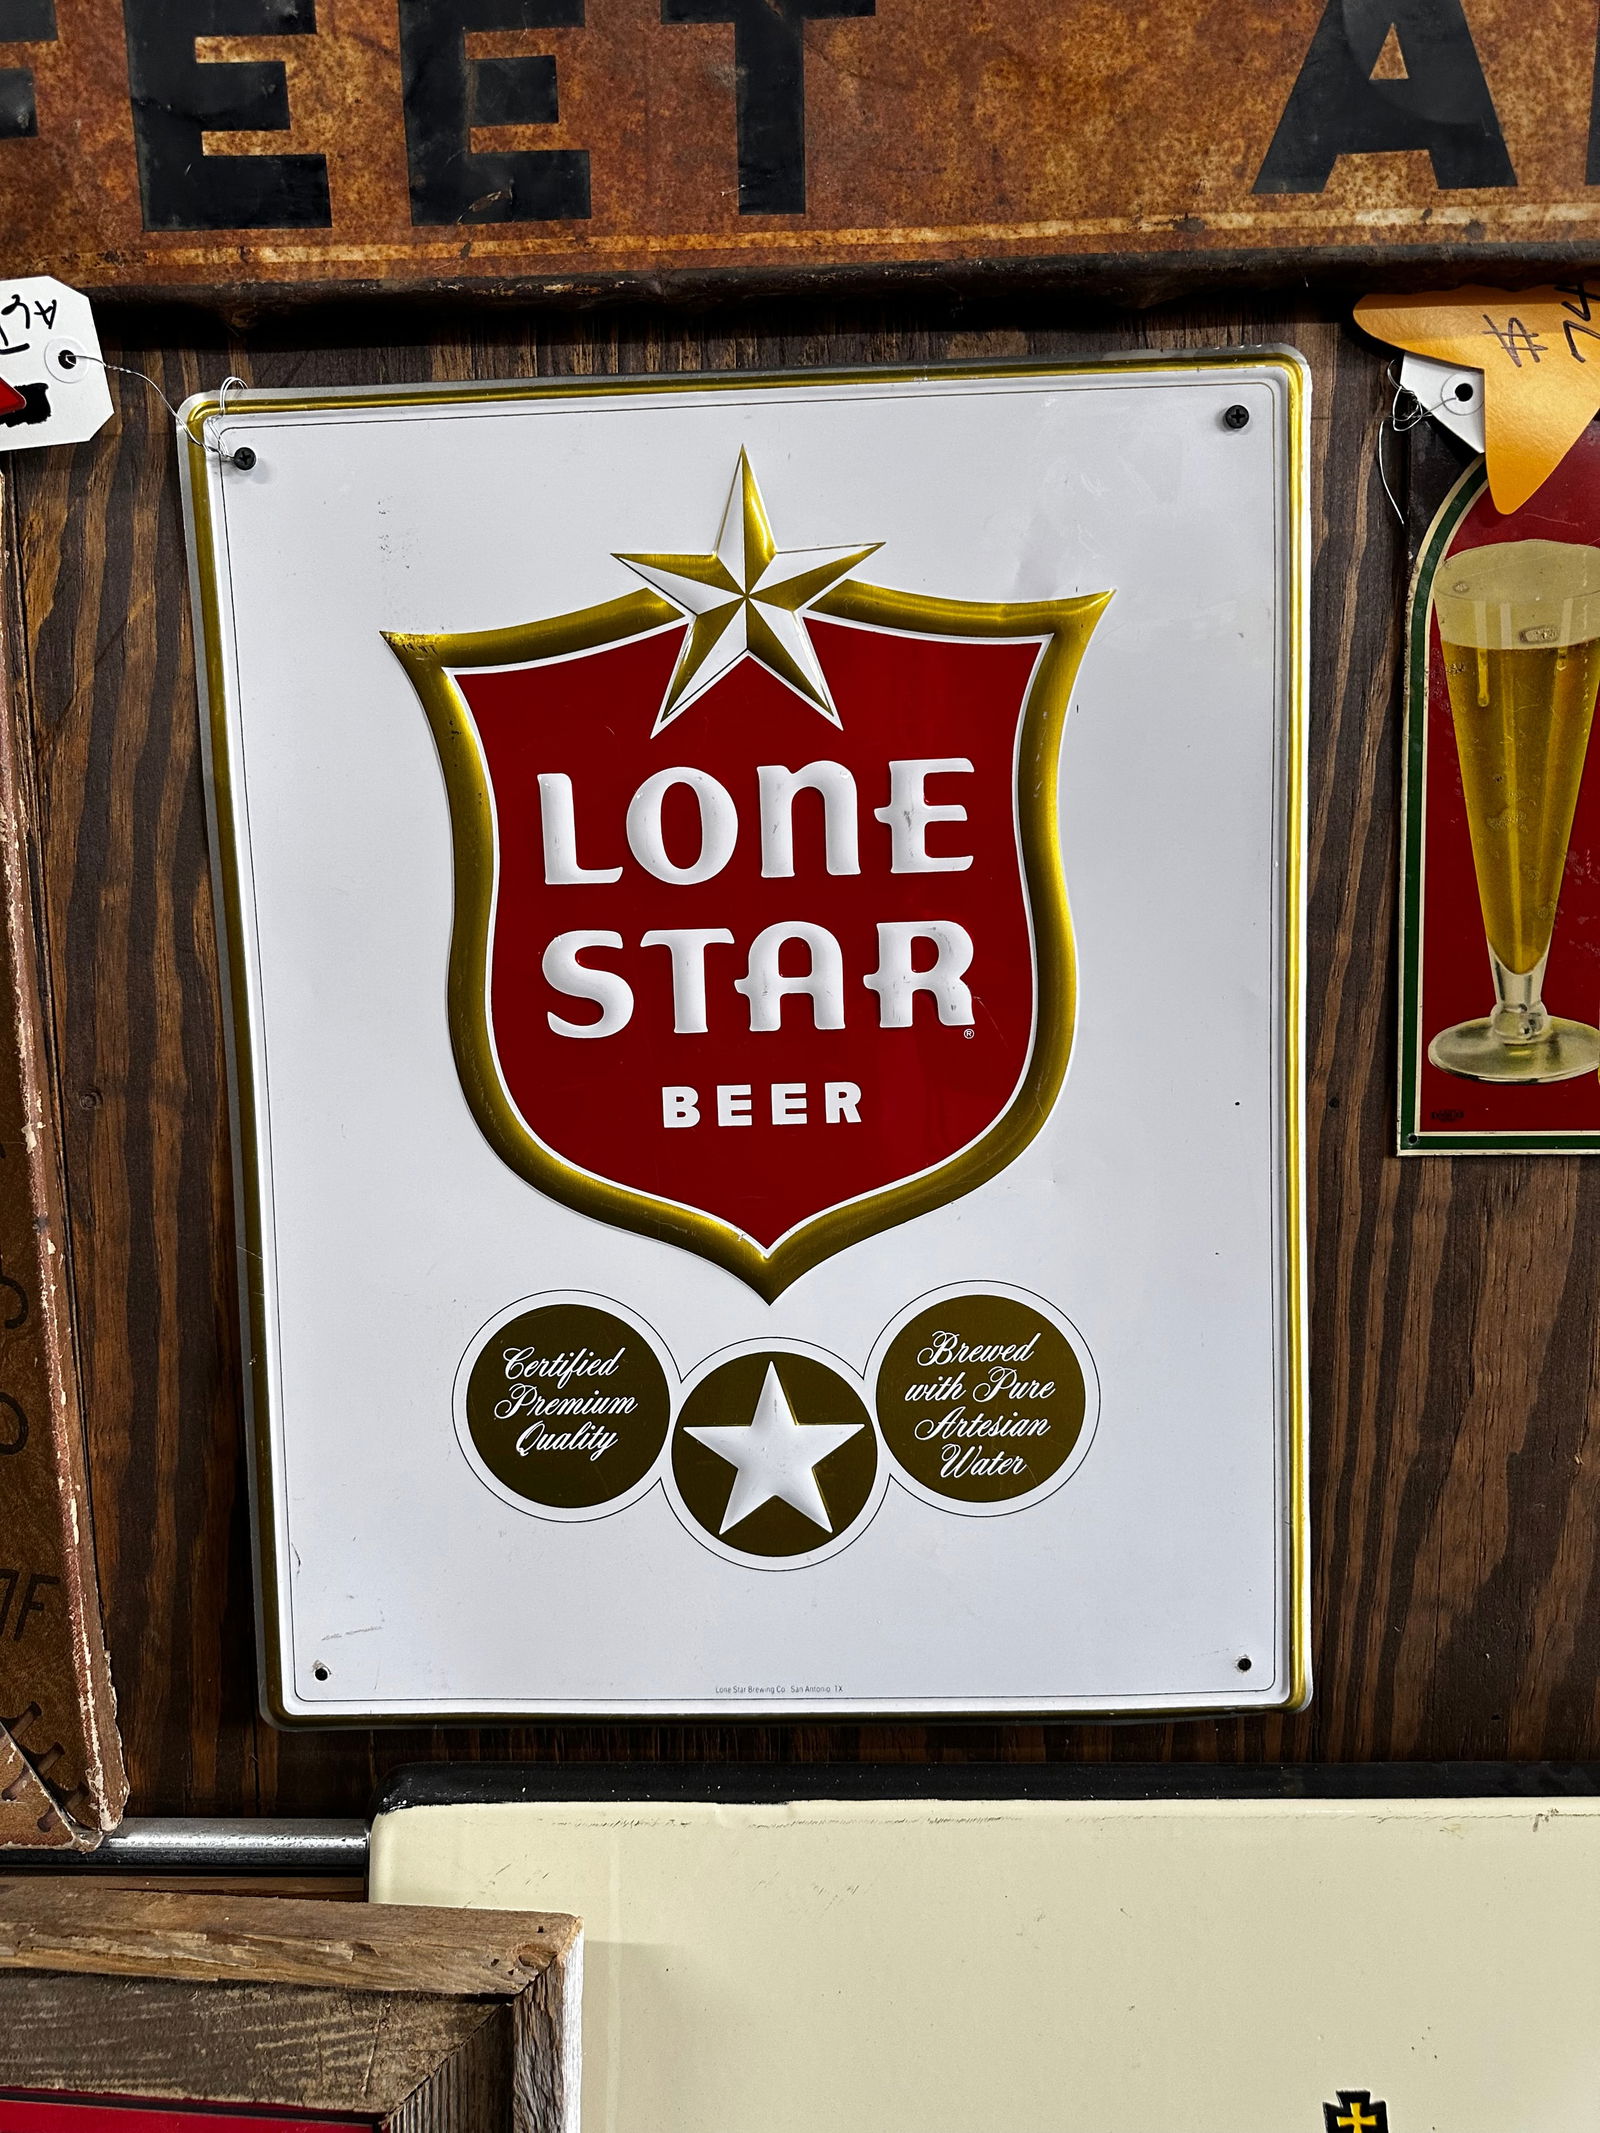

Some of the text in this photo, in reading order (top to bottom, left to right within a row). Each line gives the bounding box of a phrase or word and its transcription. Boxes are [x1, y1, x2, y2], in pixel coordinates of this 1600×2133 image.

[537, 757, 975, 886] LONE
[541, 920, 975, 1038] STAR
[661, 1081, 862, 1129] BEER
[916, 1330, 1042, 1367] Brewed
[503, 1346, 626, 1390] Certified
[904, 1366, 1057, 1403] with Pure
[494, 1382, 639, 1420] Premium
[516, 1420, 619, 1462] Quality
[914, 1406, 1052, 1441] Artesian
[940, 1443, 1028, 1479] Water
[715, 1684, 732, 1694] Lone
[732, 1684, 747, 1694] Star
[747, 1684, 775, 1695] Brewing
[790, 1684, 804, 1694] San
